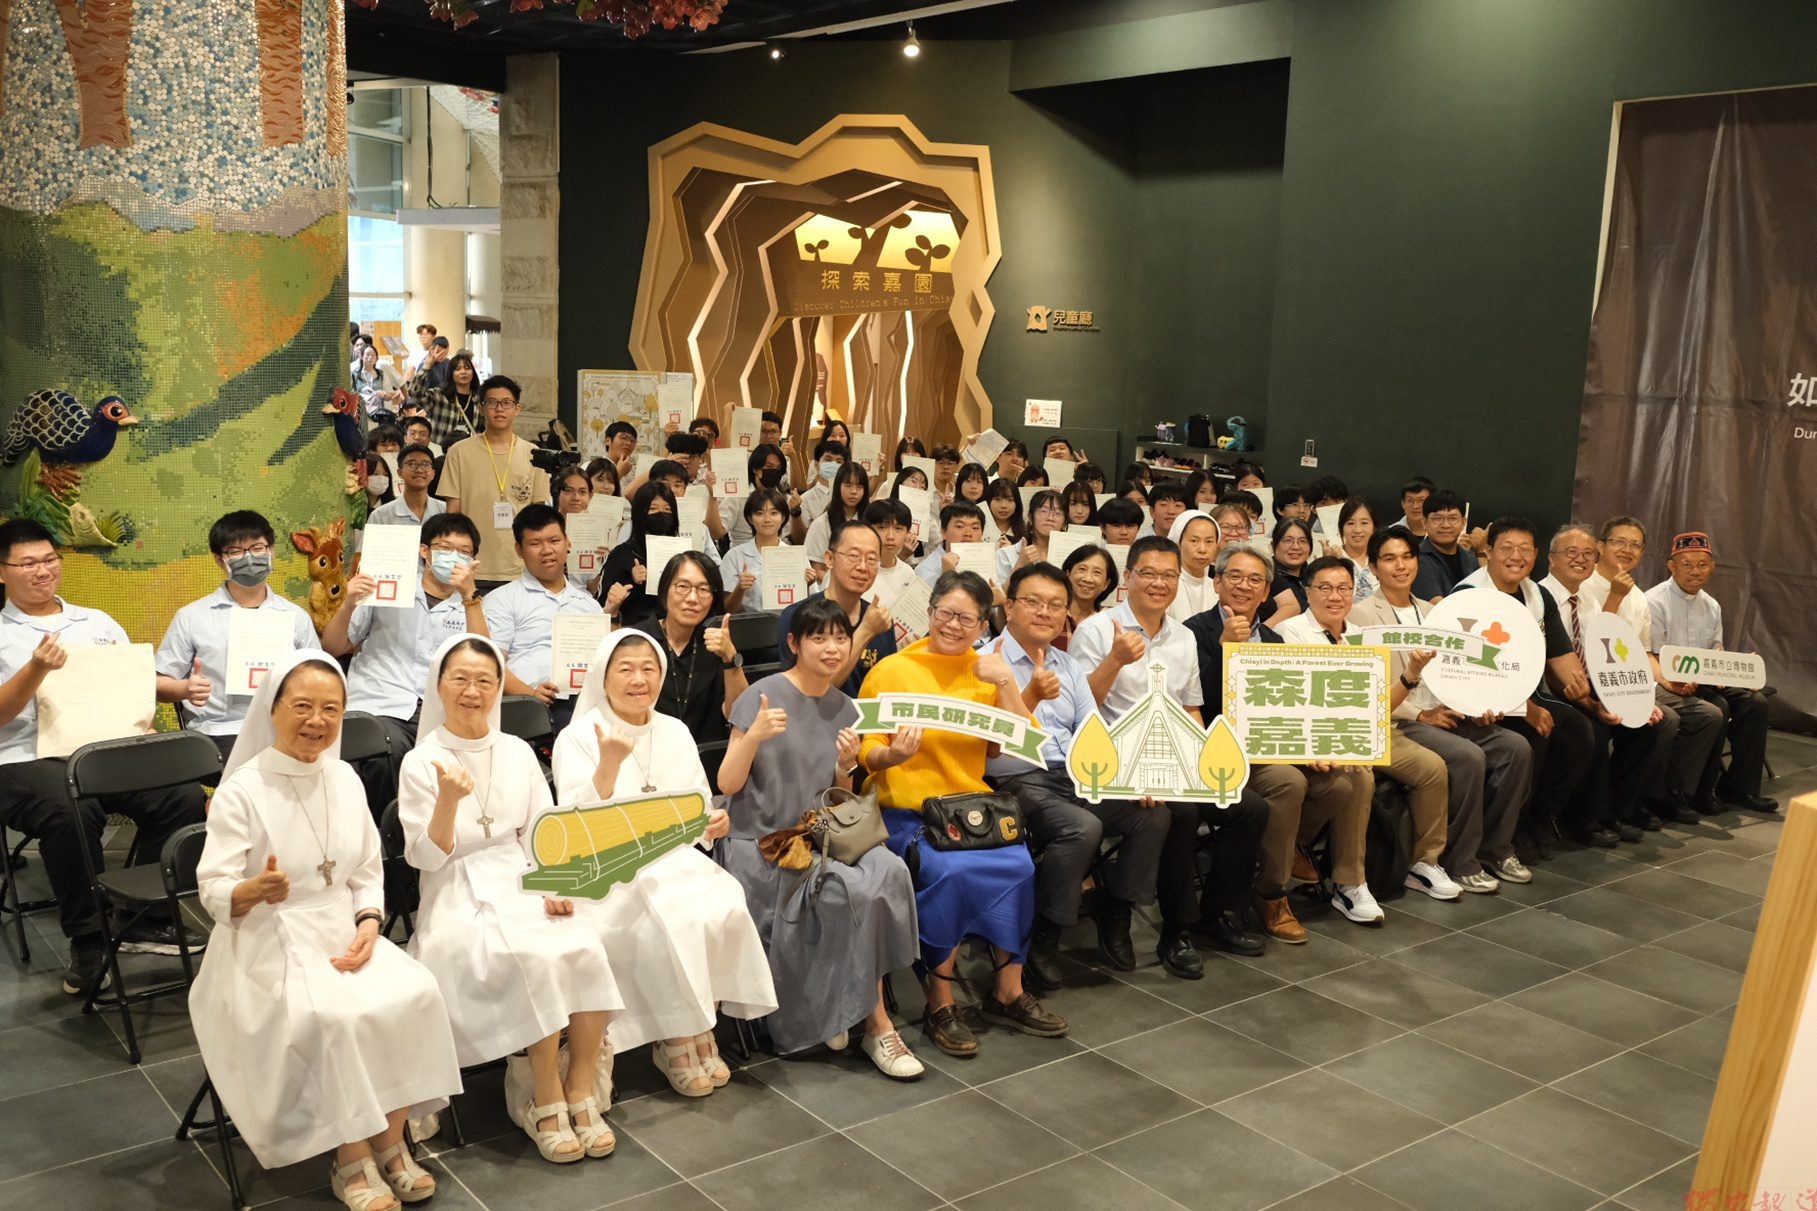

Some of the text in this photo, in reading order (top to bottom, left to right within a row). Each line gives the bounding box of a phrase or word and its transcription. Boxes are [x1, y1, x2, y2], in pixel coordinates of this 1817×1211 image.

[821, 269, 933, 293] 探索嘉園
[893, 296, 909, 306] Fun
[914, 295, 925, 305] in
[929, 295, 953, 304] Chia
[1053, 310, 1094, 327] 兒童廳
[1787, 372, 1817, 407] 如
[1794, 426, 1817, 439] Dur
[1382, 631, 1466, 650] 館校合作
[1597, 668, 1649, 688] 嘉義市政府
[1244, 716, 1372, 756] 嘉義
